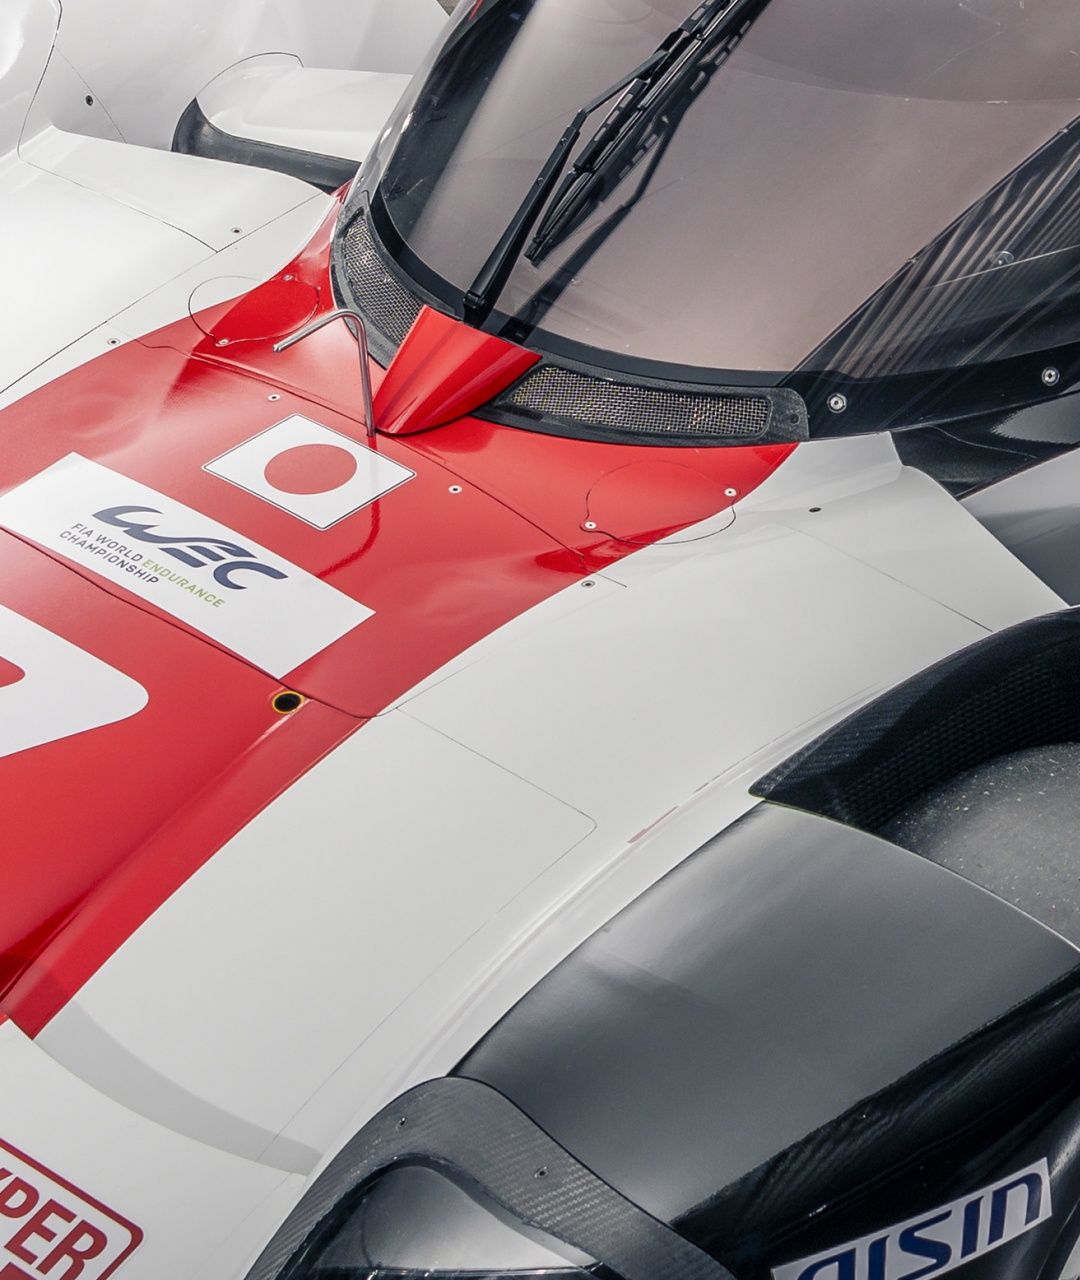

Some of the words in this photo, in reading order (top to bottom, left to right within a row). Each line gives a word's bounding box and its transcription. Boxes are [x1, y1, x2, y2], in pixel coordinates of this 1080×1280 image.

[59, 529, 160, 587] CHAMPIONSHIP
[71, 521, 93, 537] FIA
[96, 534, 144, 563] WORLD
[141, 558, 225, 609] ENDURANCE
[92, 505, 289, 590] WEC
